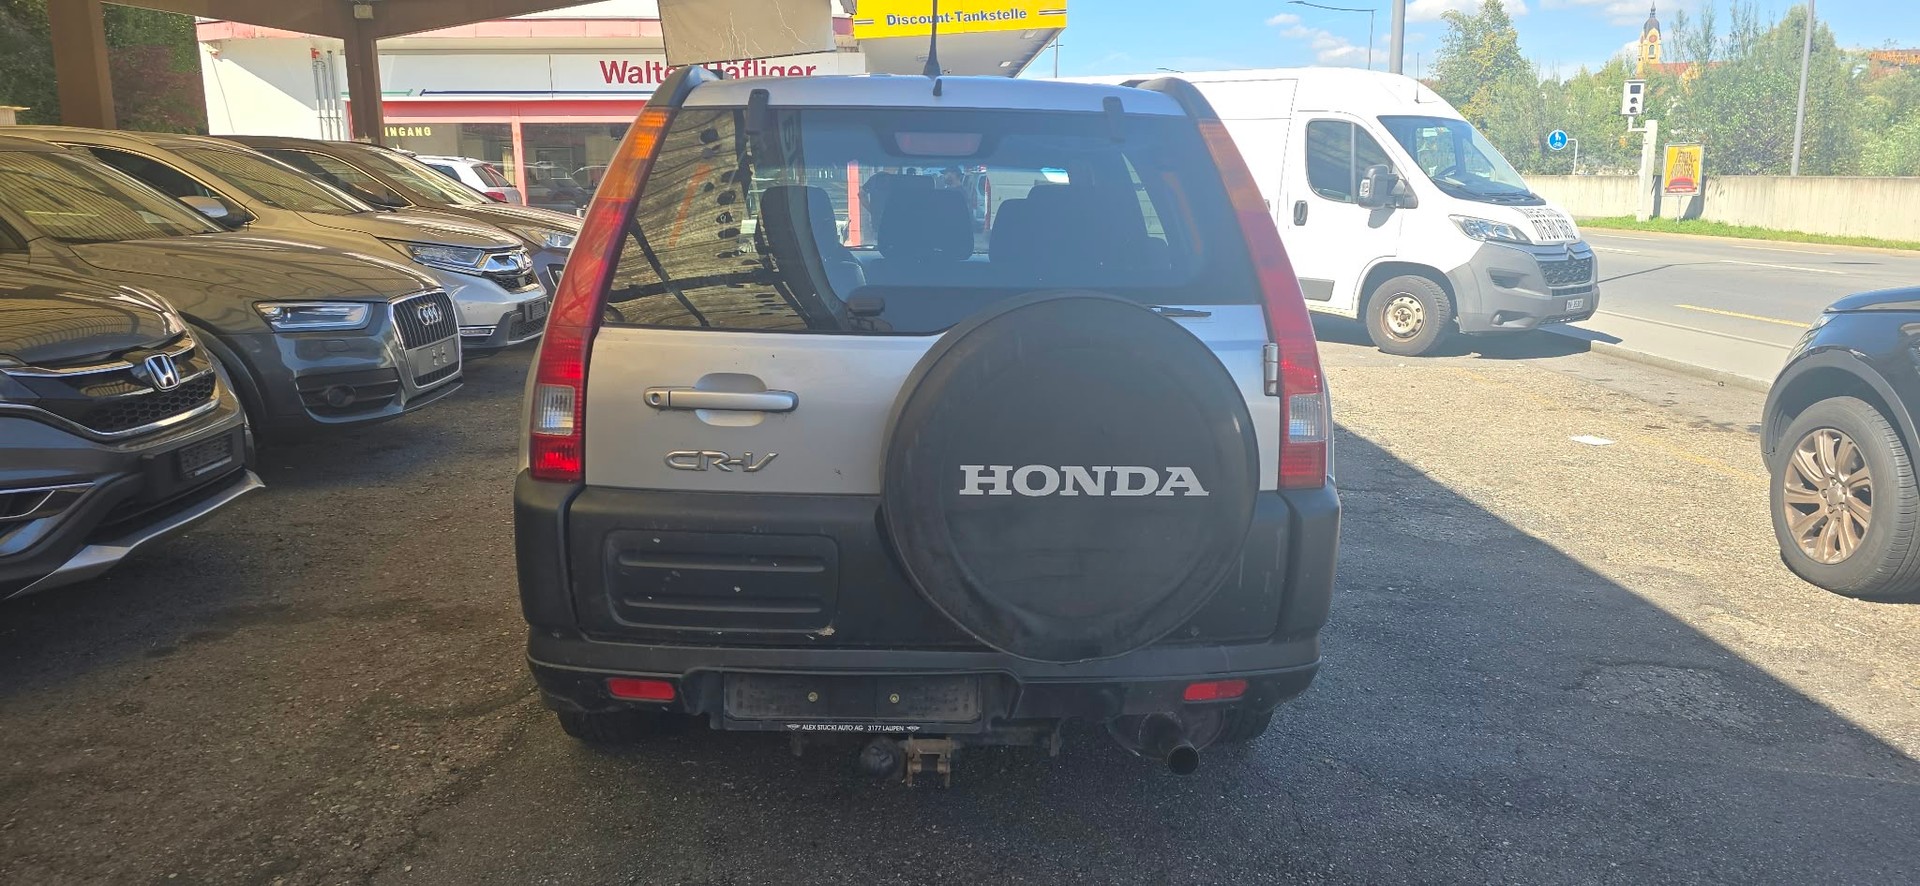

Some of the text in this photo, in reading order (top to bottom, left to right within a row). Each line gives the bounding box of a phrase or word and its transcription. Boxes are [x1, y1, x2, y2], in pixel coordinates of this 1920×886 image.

[887, 8, 1027, 26] Discount-Tankstelle
[600, 59, 817, 84] Walt äfliger
[663, 450, 779, 472] CR-V
[959, 464, 1210, 497] HONDA
